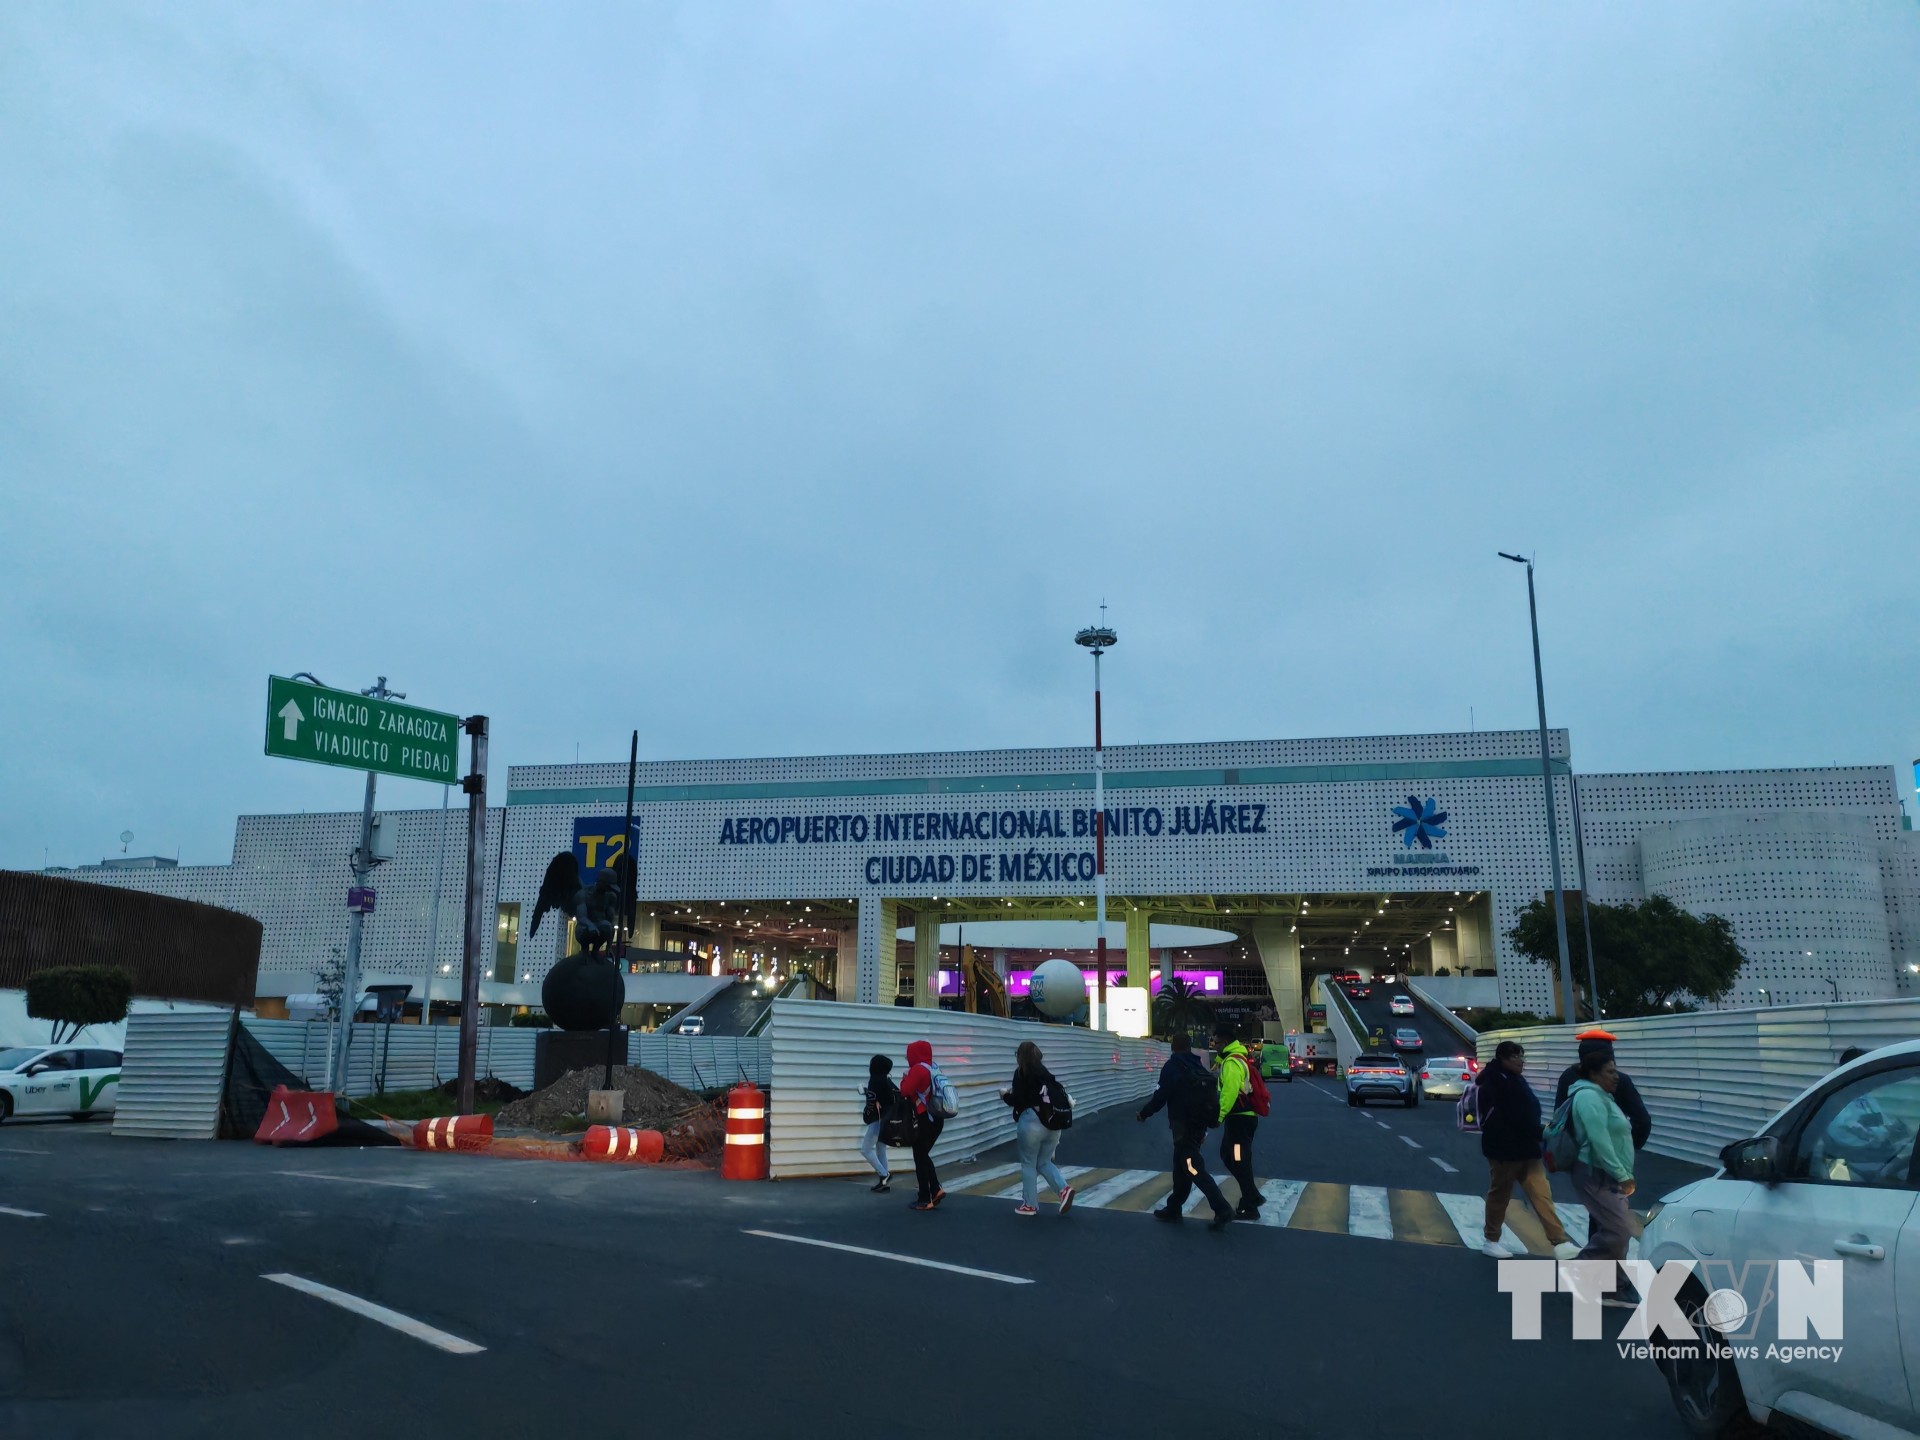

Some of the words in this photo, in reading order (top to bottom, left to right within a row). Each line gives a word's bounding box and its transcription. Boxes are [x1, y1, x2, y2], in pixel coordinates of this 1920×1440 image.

[313, 697, 368, 727] IGNACIO
[379, 710, 447, 743] ZARAGOZA
[315, 730, 388, 762] VIADUCTO
[401, 747, 450, 773] PIEDAD
[718, 815, 868, 845] AEROPUERTO
[876, 810, 1066, 840] INTERNACIONAL
[1072, 807, 1163, 838] BENITO
[1168, 799, 1267, 836] JUÁREZ
[578, 834, 632, 868] T2
[865, 855, 955, 884] CIUDAD
[961, 854, 992, 882] DE
[1000, 849, 1096, 882] MÉXICO
[25, 1085, 46, 1094] Uber
